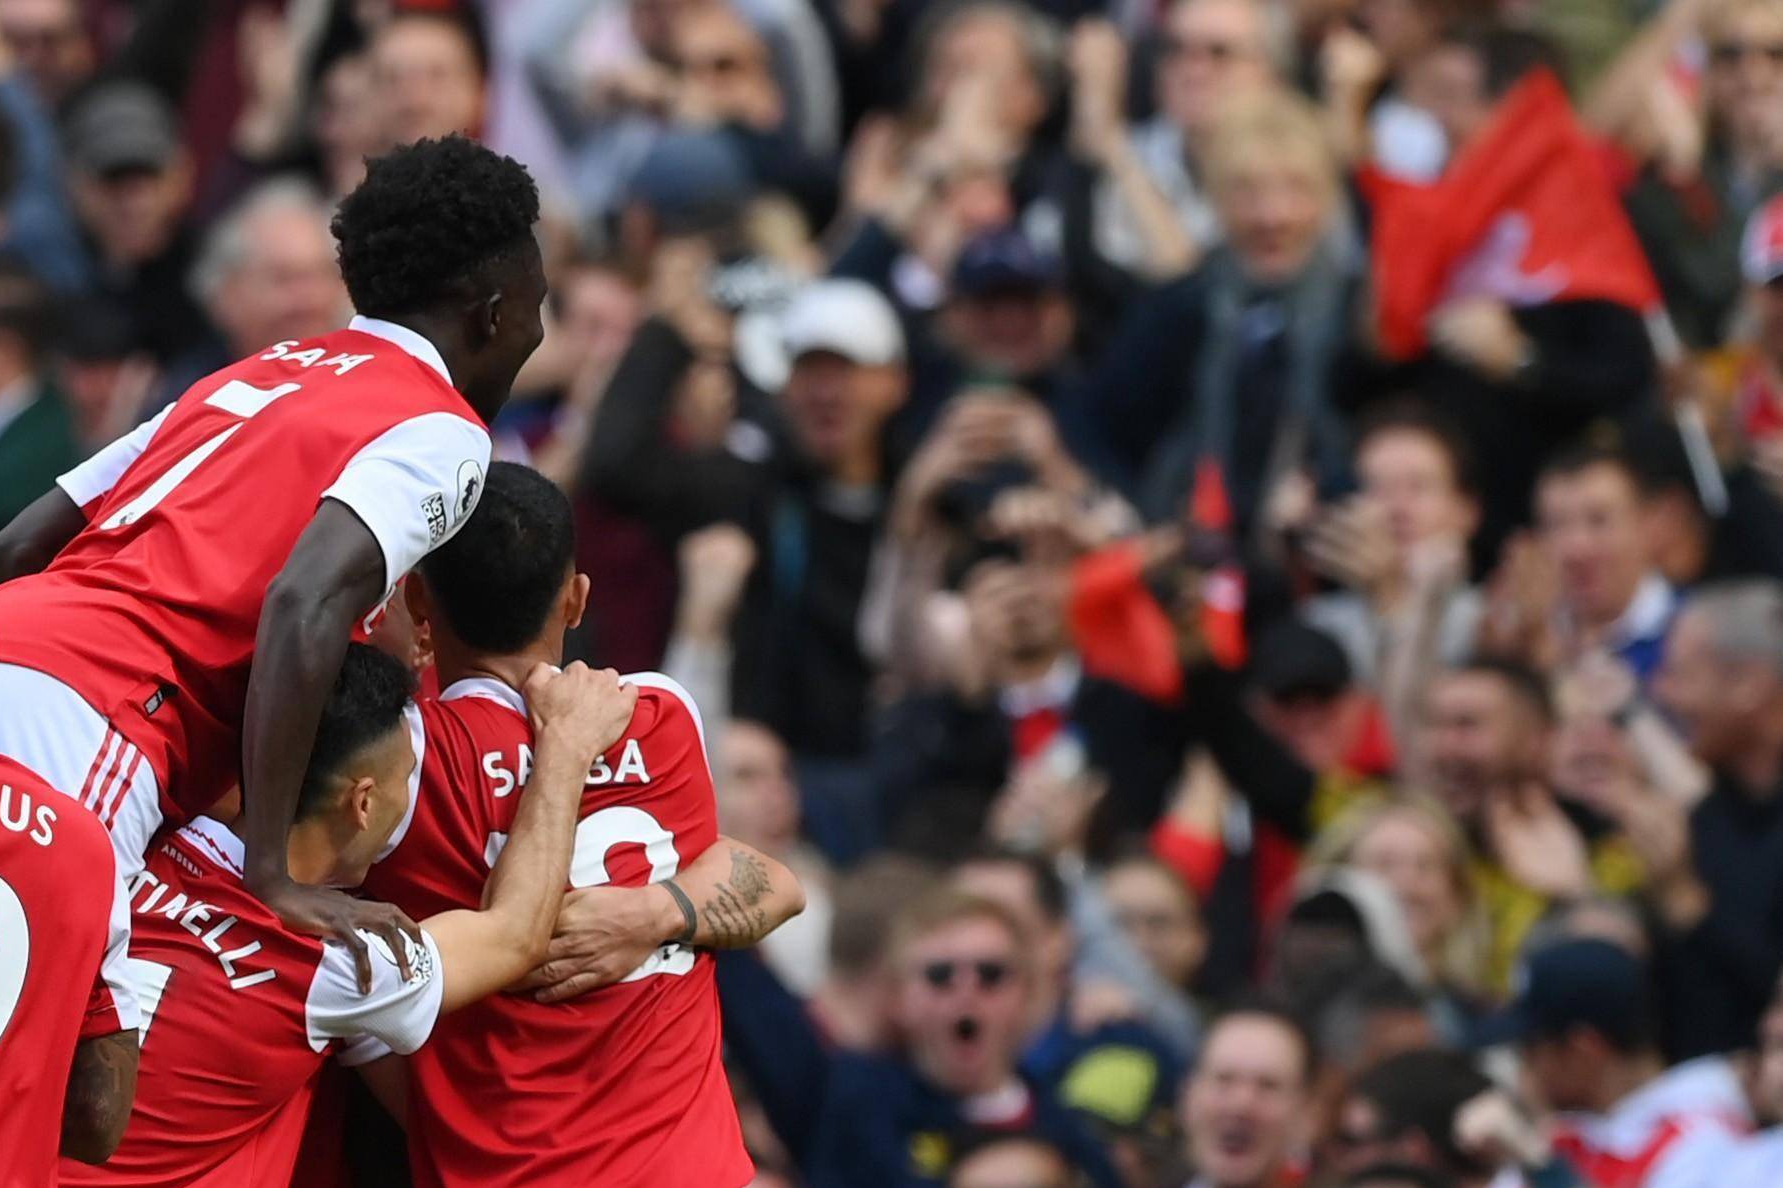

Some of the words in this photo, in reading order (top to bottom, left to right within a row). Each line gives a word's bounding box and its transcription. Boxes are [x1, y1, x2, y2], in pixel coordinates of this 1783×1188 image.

[100, 379, 302, 531] 7
[482, 738, 651, 798] SABA
[126, 869, 277, 990] TINELLI
